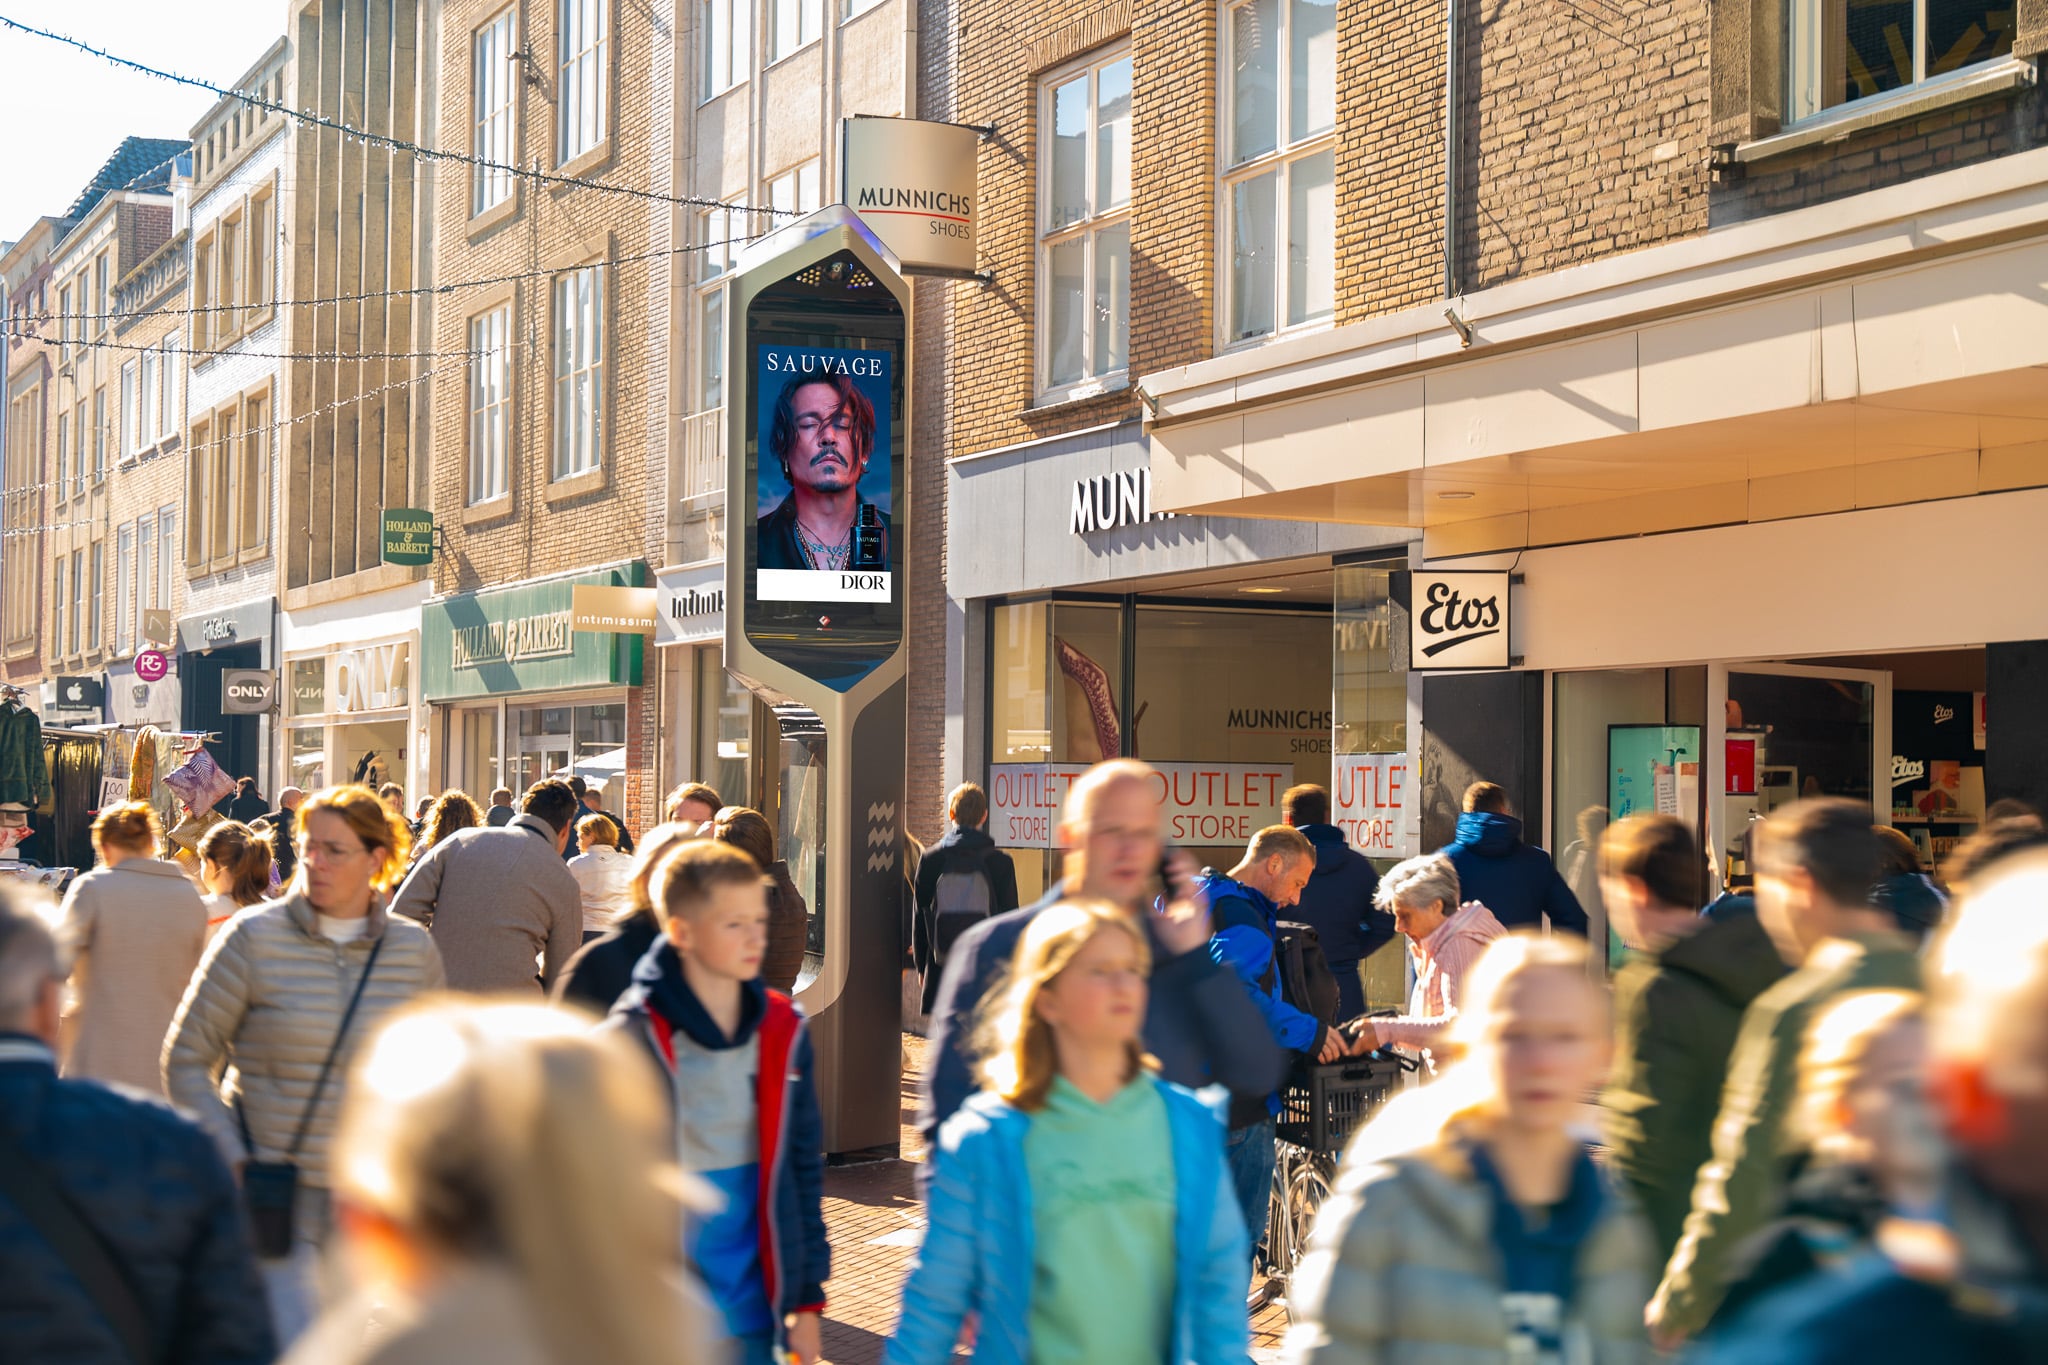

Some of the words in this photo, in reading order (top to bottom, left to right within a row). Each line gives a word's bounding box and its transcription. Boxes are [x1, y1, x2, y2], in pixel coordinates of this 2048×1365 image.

[858, 188, 970, 215] MUNNICHS
[930, 221, 970, 240] SHOES
[767, 352, 883, 377] SAUVAGE
[386, 521, 432, 533] HOLLAND
[403, 532, 413, 543] &
[386, 542, 430, 554] BARRETT
[841, 574, 885, 590] DIOR
[1420, 582, 1500, 635] Etos
[577, 614, 657, 628] intimissimi
[452, 621, 504, 669] HOLLAND
[504, 619, 518, 664] &
[518, 609, 573, 656] BARRETT
[140, 654, 162, 672] PG
[336, 644, 397, 712] ONLY
[228, 685, 271, 698] ONLY
[1227, 708, 1332, 730] MUNNICHS
[1934, 704, 1954, 720] Etos
[1290, 738, 1332, 754] SHOES
[1892, 755, 1925, 778] Etos
[994, 772, 1082, 808] OUTLET
[1337, 765, 1407, 809] UTLE
[1009, 816, 1047, 841] STORE
[1172, 814, 1250, 839] STORE
